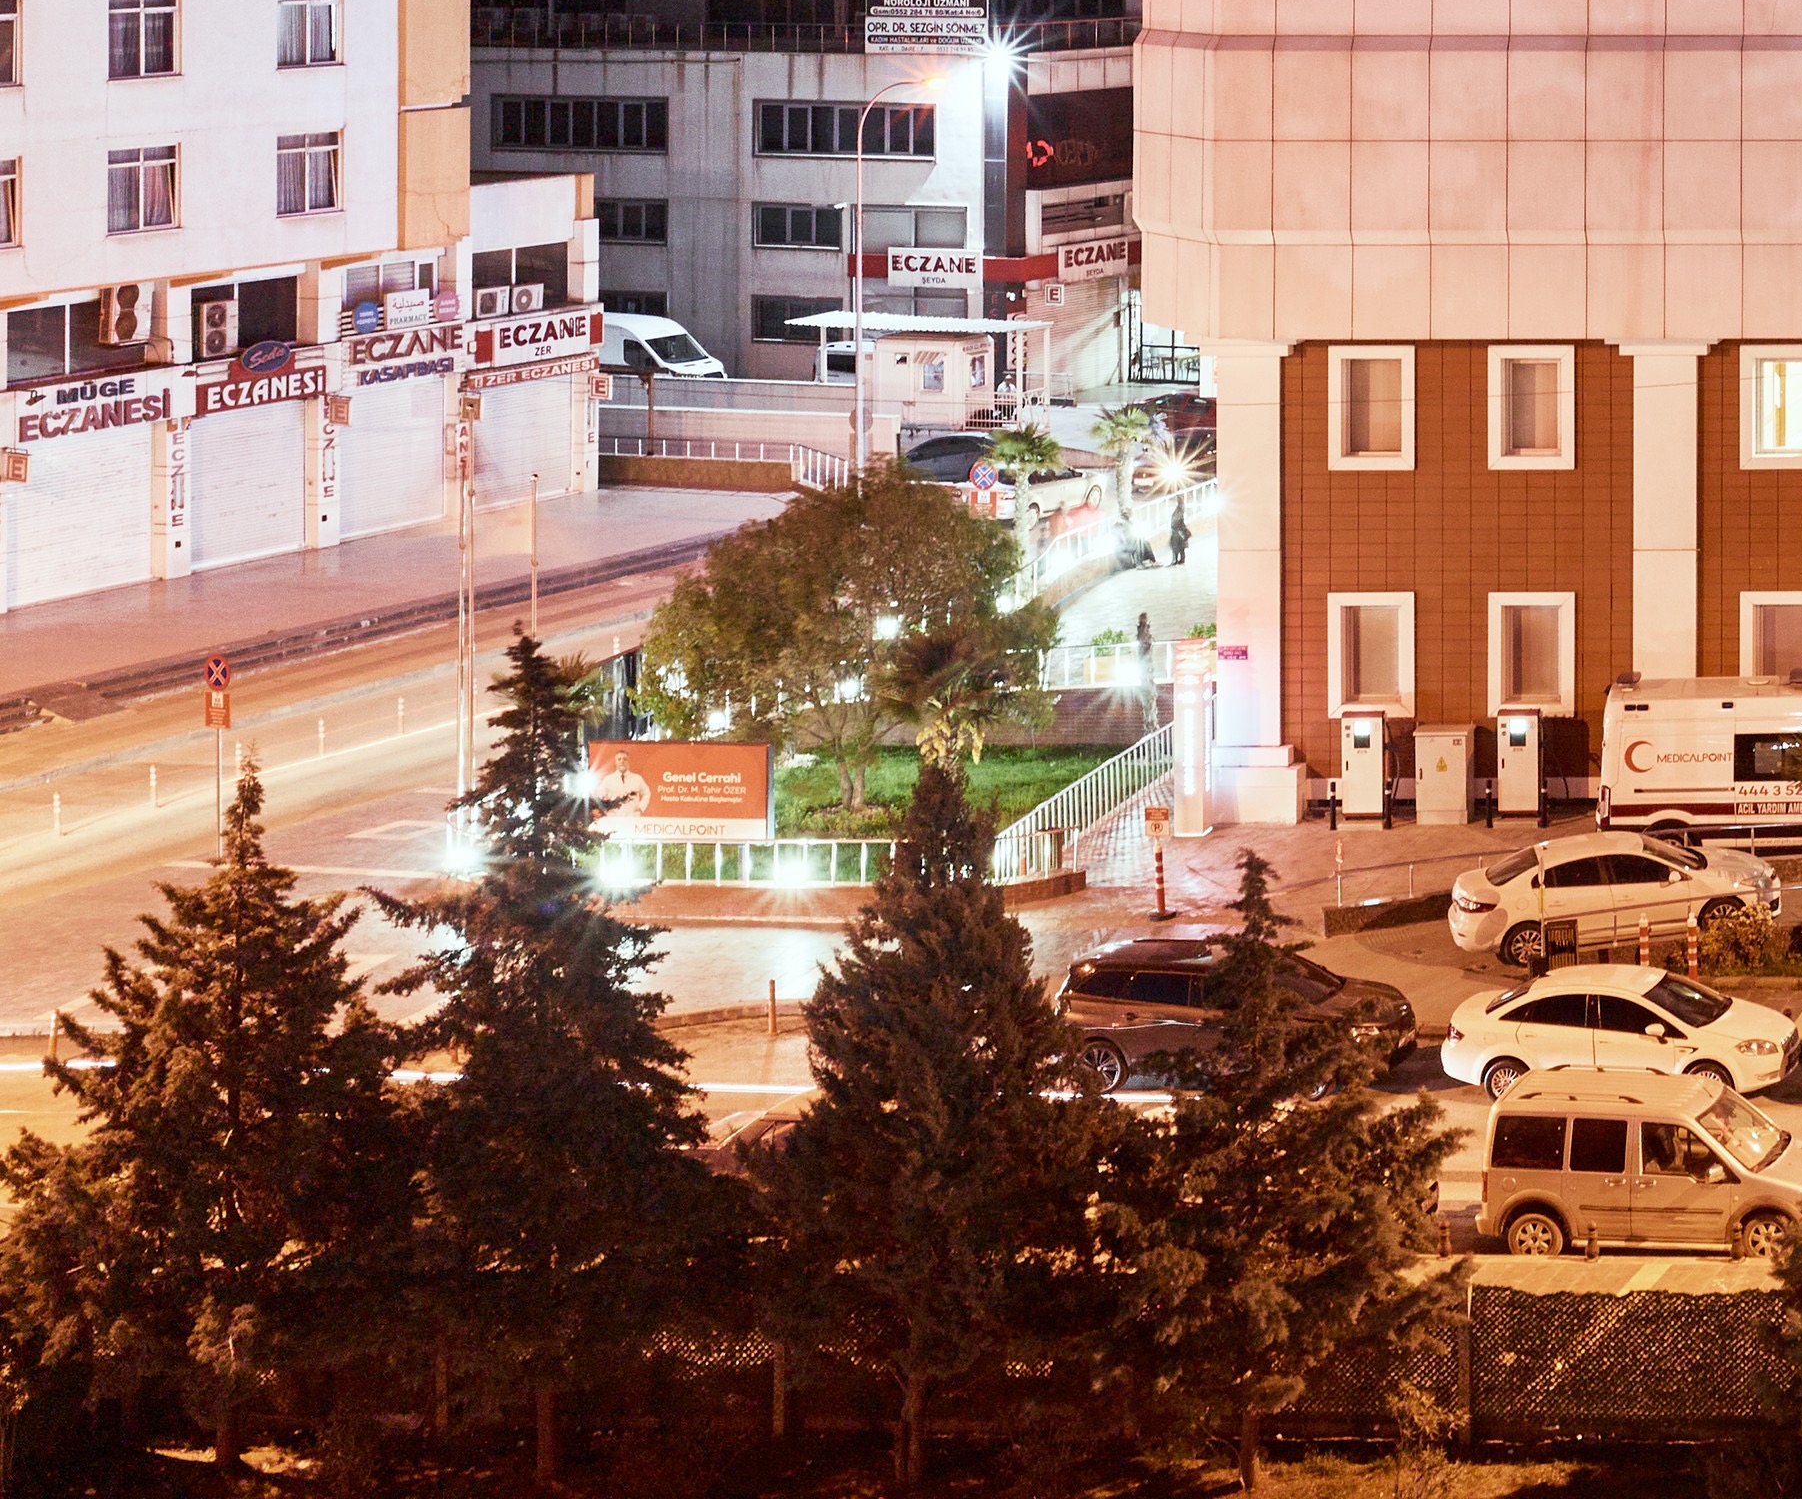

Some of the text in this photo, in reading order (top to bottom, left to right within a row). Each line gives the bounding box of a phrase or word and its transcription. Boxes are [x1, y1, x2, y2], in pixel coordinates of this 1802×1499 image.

[933, 0, 969, 7] UZMANI
[867, 21, 985, 33] OPR. DR. SEZGİN SÖNMEZ
[1064, 241, 1126, 269] ECZANE
[891, 254, 977, 274] ECZANE
[922, 276, 946, 285] ŞEYDA
[389, 314, 428, 325] PHARMACY
[500, 316, 587, 349] ECZANE
[350, 325, 463, 366] ECZANE
[535, 346, 552, 357] ZER
[486, 373, 517, 387] ZER
[56, 378, 135, 405] MÜGE
[1656, 752, 1733, 763] MEDICALPOINT
[662, 772, 741, 784] Genel Cerrahi
[657, 784, 746, 794] Prof. Dr. M. Tahir ÖZER
[1738, 785, 1769, 796] 444
[1773, 785, 1781, 796] 3
[1737, 802, 1756, 814] ACİL
[1757, 802, 1786, 814] YARDIM
[635, 823, 726, 836] MEDICALPOINT
